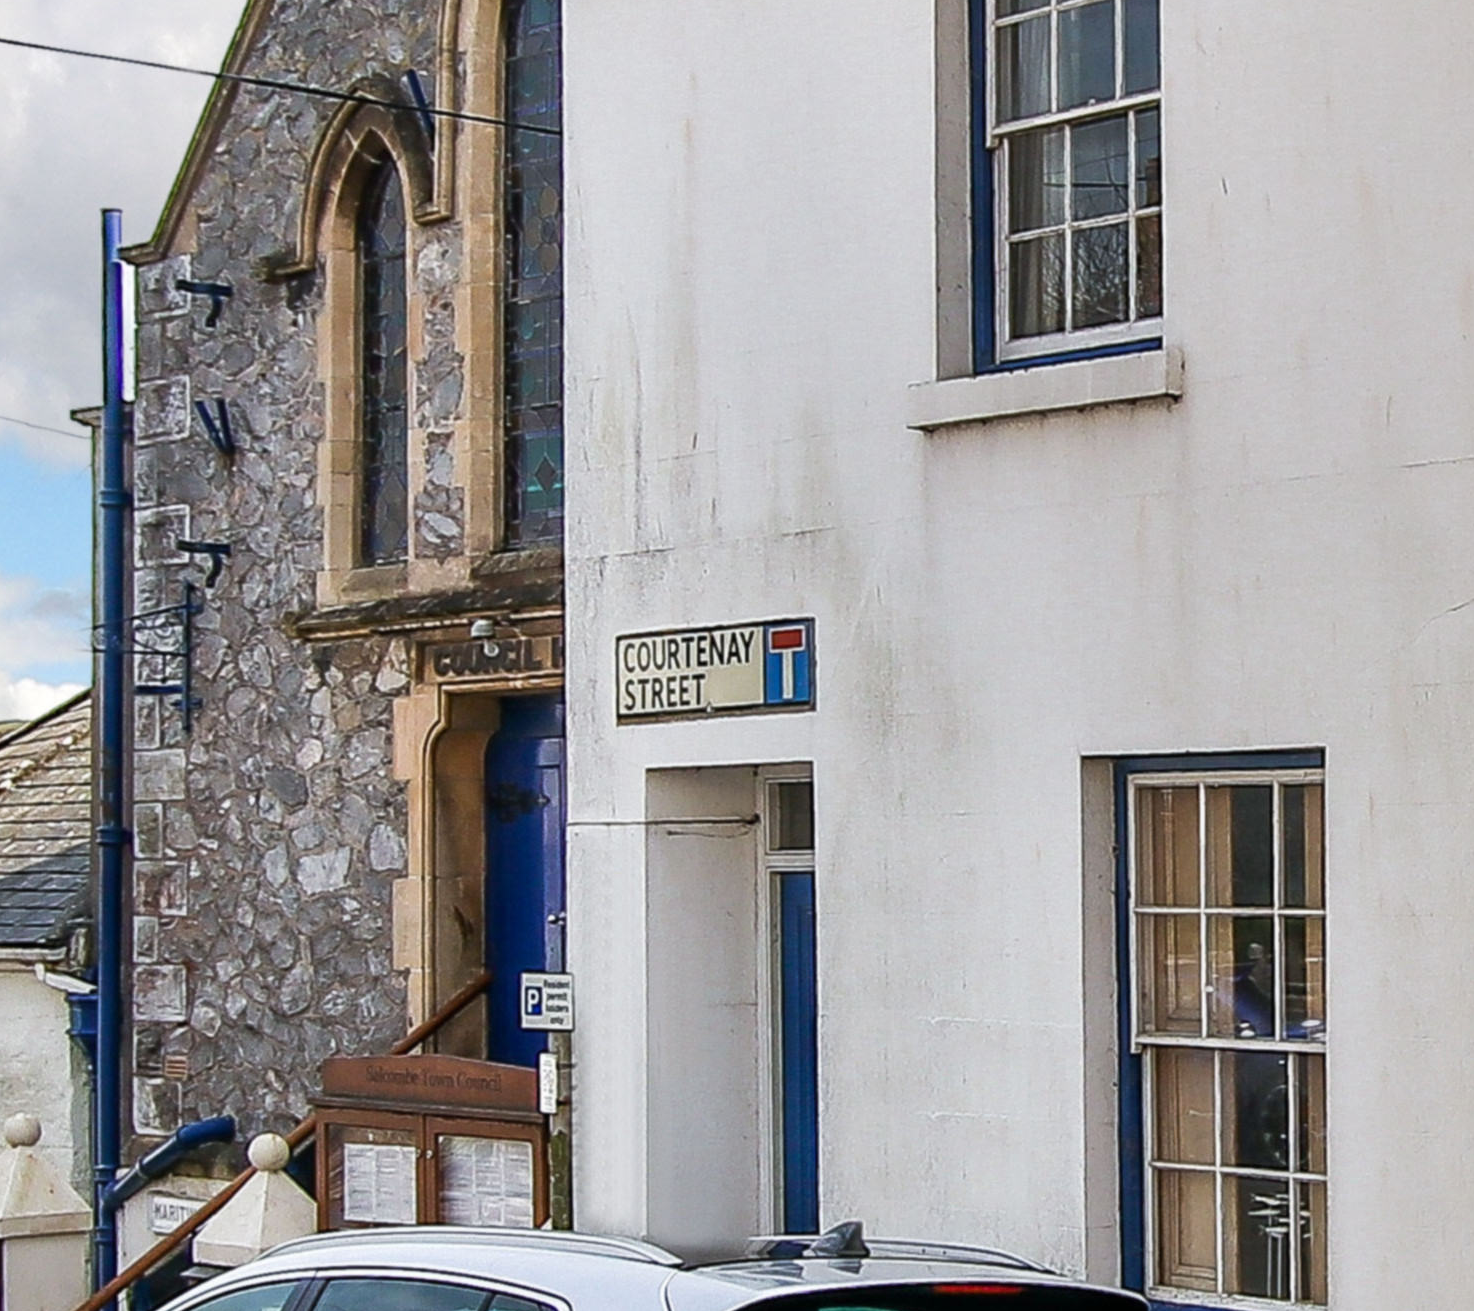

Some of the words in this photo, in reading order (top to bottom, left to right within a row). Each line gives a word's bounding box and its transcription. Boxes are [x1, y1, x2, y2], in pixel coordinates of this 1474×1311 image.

[434, 638, 543, 677] COUNCIL
[623, 631, 756, 674] COURTENAY
[623, 673, 707, 712] STREET
[456, 1072, 503, 1092] Council
